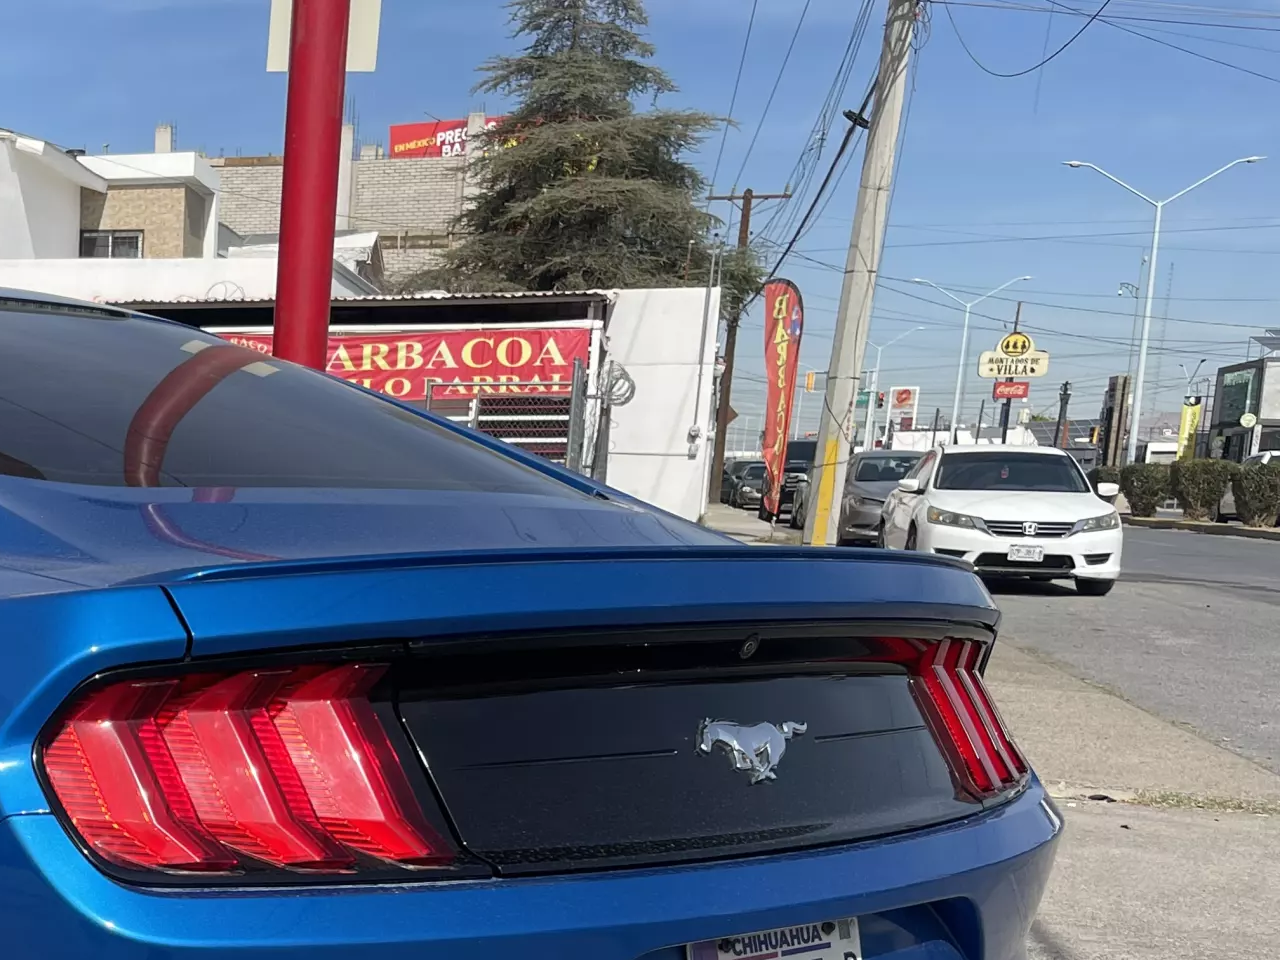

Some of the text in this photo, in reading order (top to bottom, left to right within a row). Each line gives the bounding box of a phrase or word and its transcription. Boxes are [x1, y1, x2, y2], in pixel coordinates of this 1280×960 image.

[325, 337, 569, 372] ARBACOA
[987, 357, 1041, 366] MONTADOS DE
[996, 364, 1028, 376] VILLA
[732, 924, 822, 956] CHIHUAHUA
